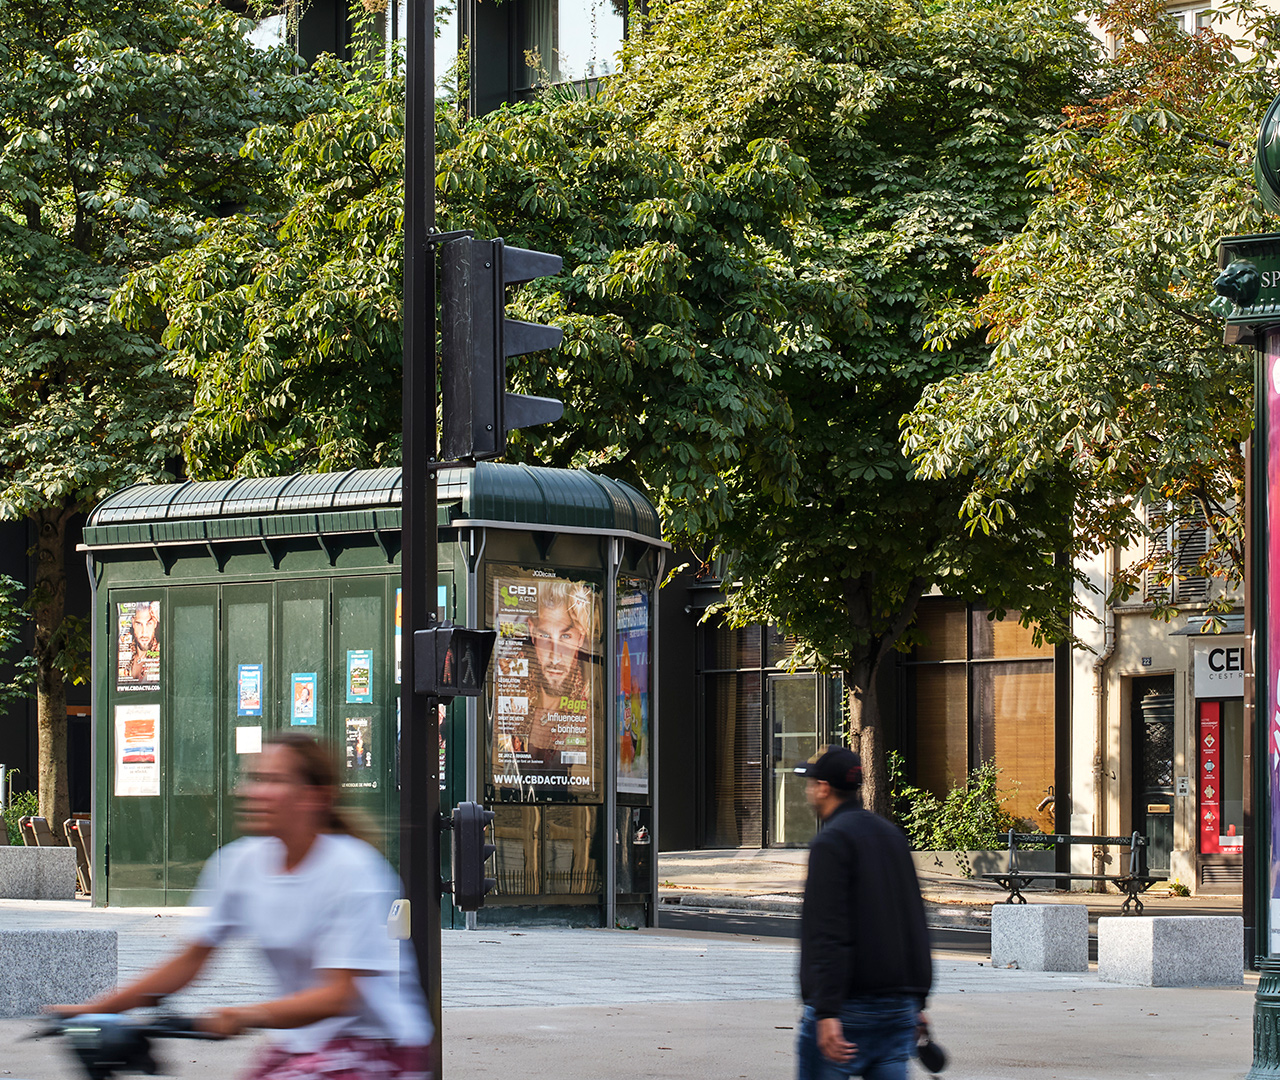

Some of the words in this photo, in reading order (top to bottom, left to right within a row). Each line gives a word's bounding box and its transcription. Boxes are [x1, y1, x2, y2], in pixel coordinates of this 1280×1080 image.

[509, 585, 537, 595] CBD
[560, 696, 587, 713] Paga
[547, 712, 587, 723] Influenceur
[558, 724, 587, 734] bonheur
[494, 774, 590, 786] WWW.CBDACTU.COM
